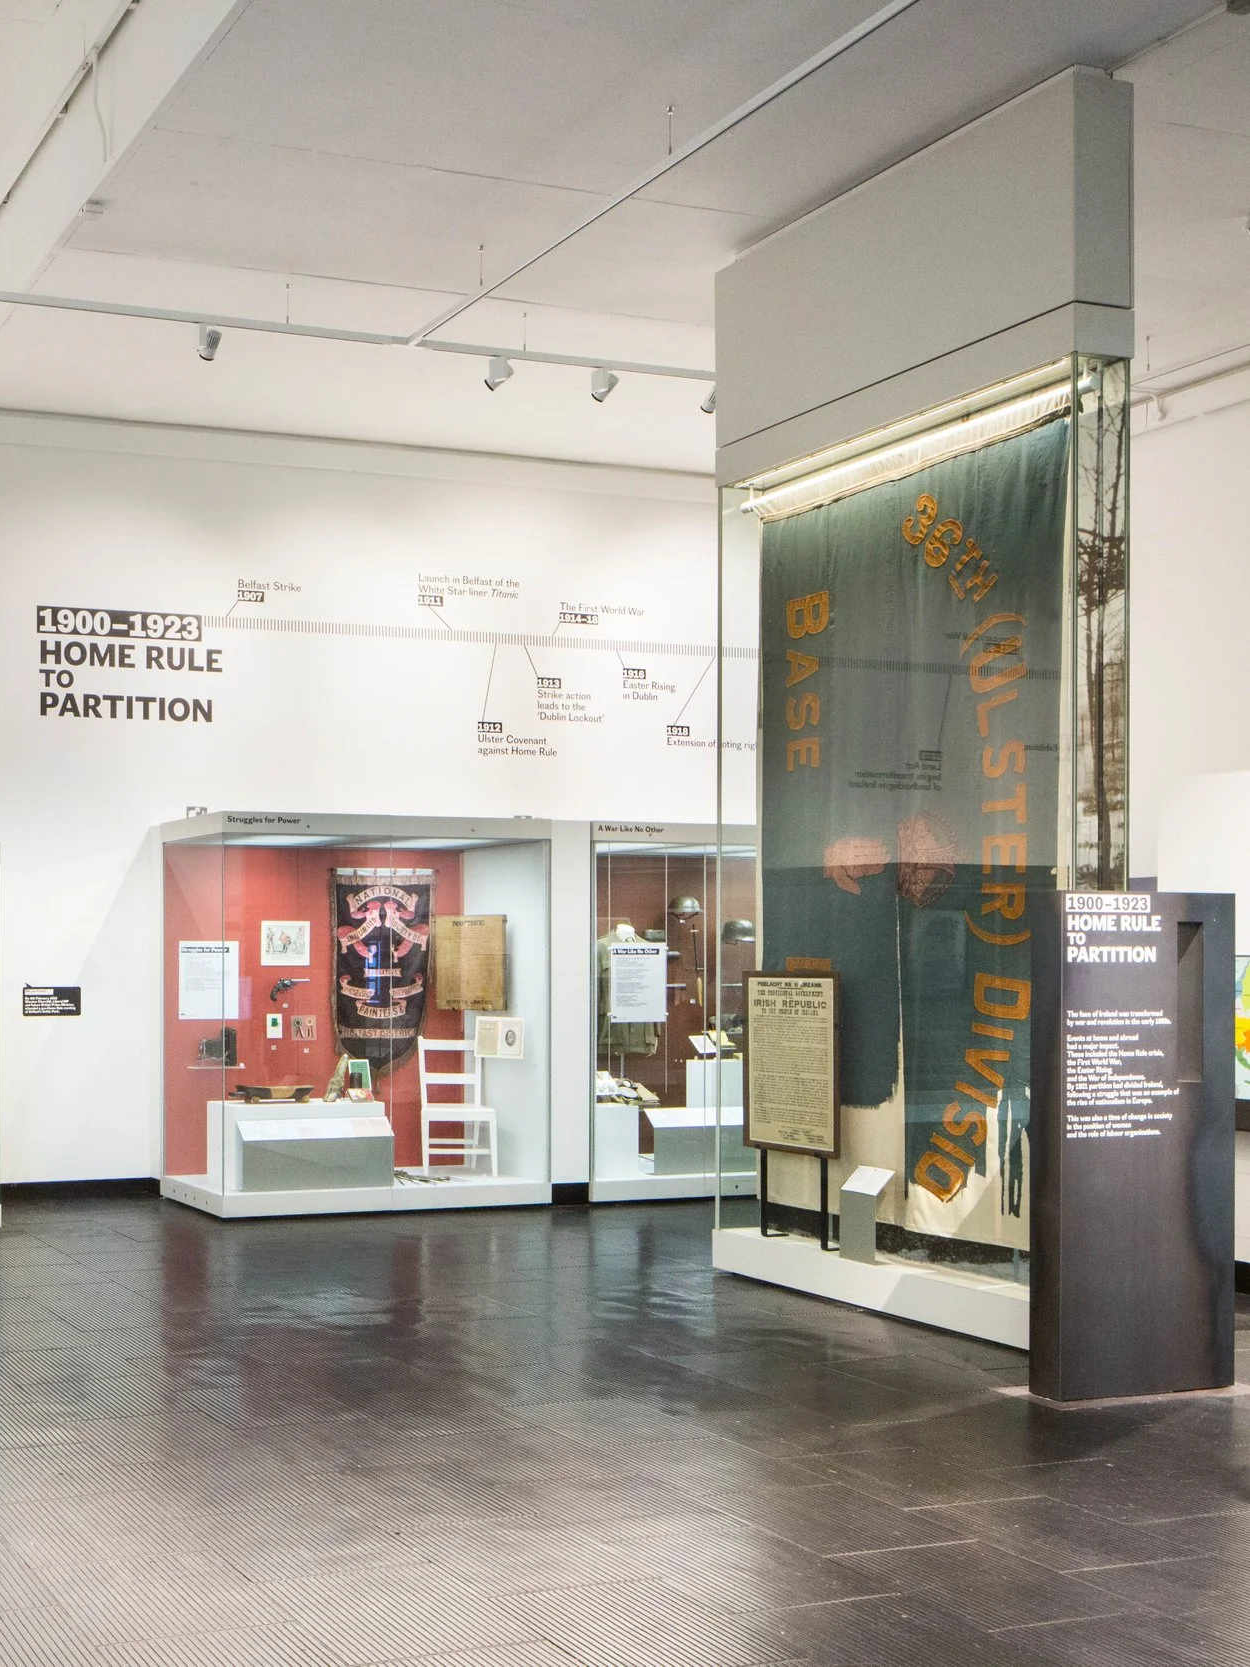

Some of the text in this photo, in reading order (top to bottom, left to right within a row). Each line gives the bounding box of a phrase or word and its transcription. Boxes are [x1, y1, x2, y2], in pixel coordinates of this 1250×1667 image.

[238, 579, 302, 592] Belfast Strike
[418, 574, 520, 588] Launch in Belfast of the
[238, 590, 263, 602] 1907
[418, 584, 518, 599] White Star liner Titanic
[418, 596, 442, 606] 1911
[560, 602, 645, 616] The First World War
[40, 608, 199, 640] 1900–1923
[560, 613, 598, 624] 1914–18
[40, 640, 222, 672] HOME RULE
[40, 669, 74, 688] TO
[623, 669, 644, 678] 1916
[538, 678, 560, 688] 1913
[623, 680, 676, 692] Easter Rising
[786, 590, 831, 772] BASE
[538, 690, 591, 700] Strike action
[623, 691, 658, 700] in Dublin
[40, 692, 212, 722] PARTITION
[538, 701, 586, 711] leads to the
[478, 722, 502, 732] 1912
[667, 726, 688, 736] 1918
[478, 734, 546, 745] Ulster Covenant
[667, 738, 706, 747] Extension
[708, 738, 716, 748] of
[720, 741, 742, 751] oting
[478, 746, 557, 756] against Home Rule
[228, 816, 262, 824] Struggles
[355, 886, 411, 906] NATIONAL
[1068, 896, 1148, 910] 1900–1923
[1067, 915, 1161, 932] HOME RULE
[1067, 932, 1086, 945] TO
[1067, 946, 1156, 963] PARTITION
[754, 999, 826, 1009] IRISH REPUBLIC
